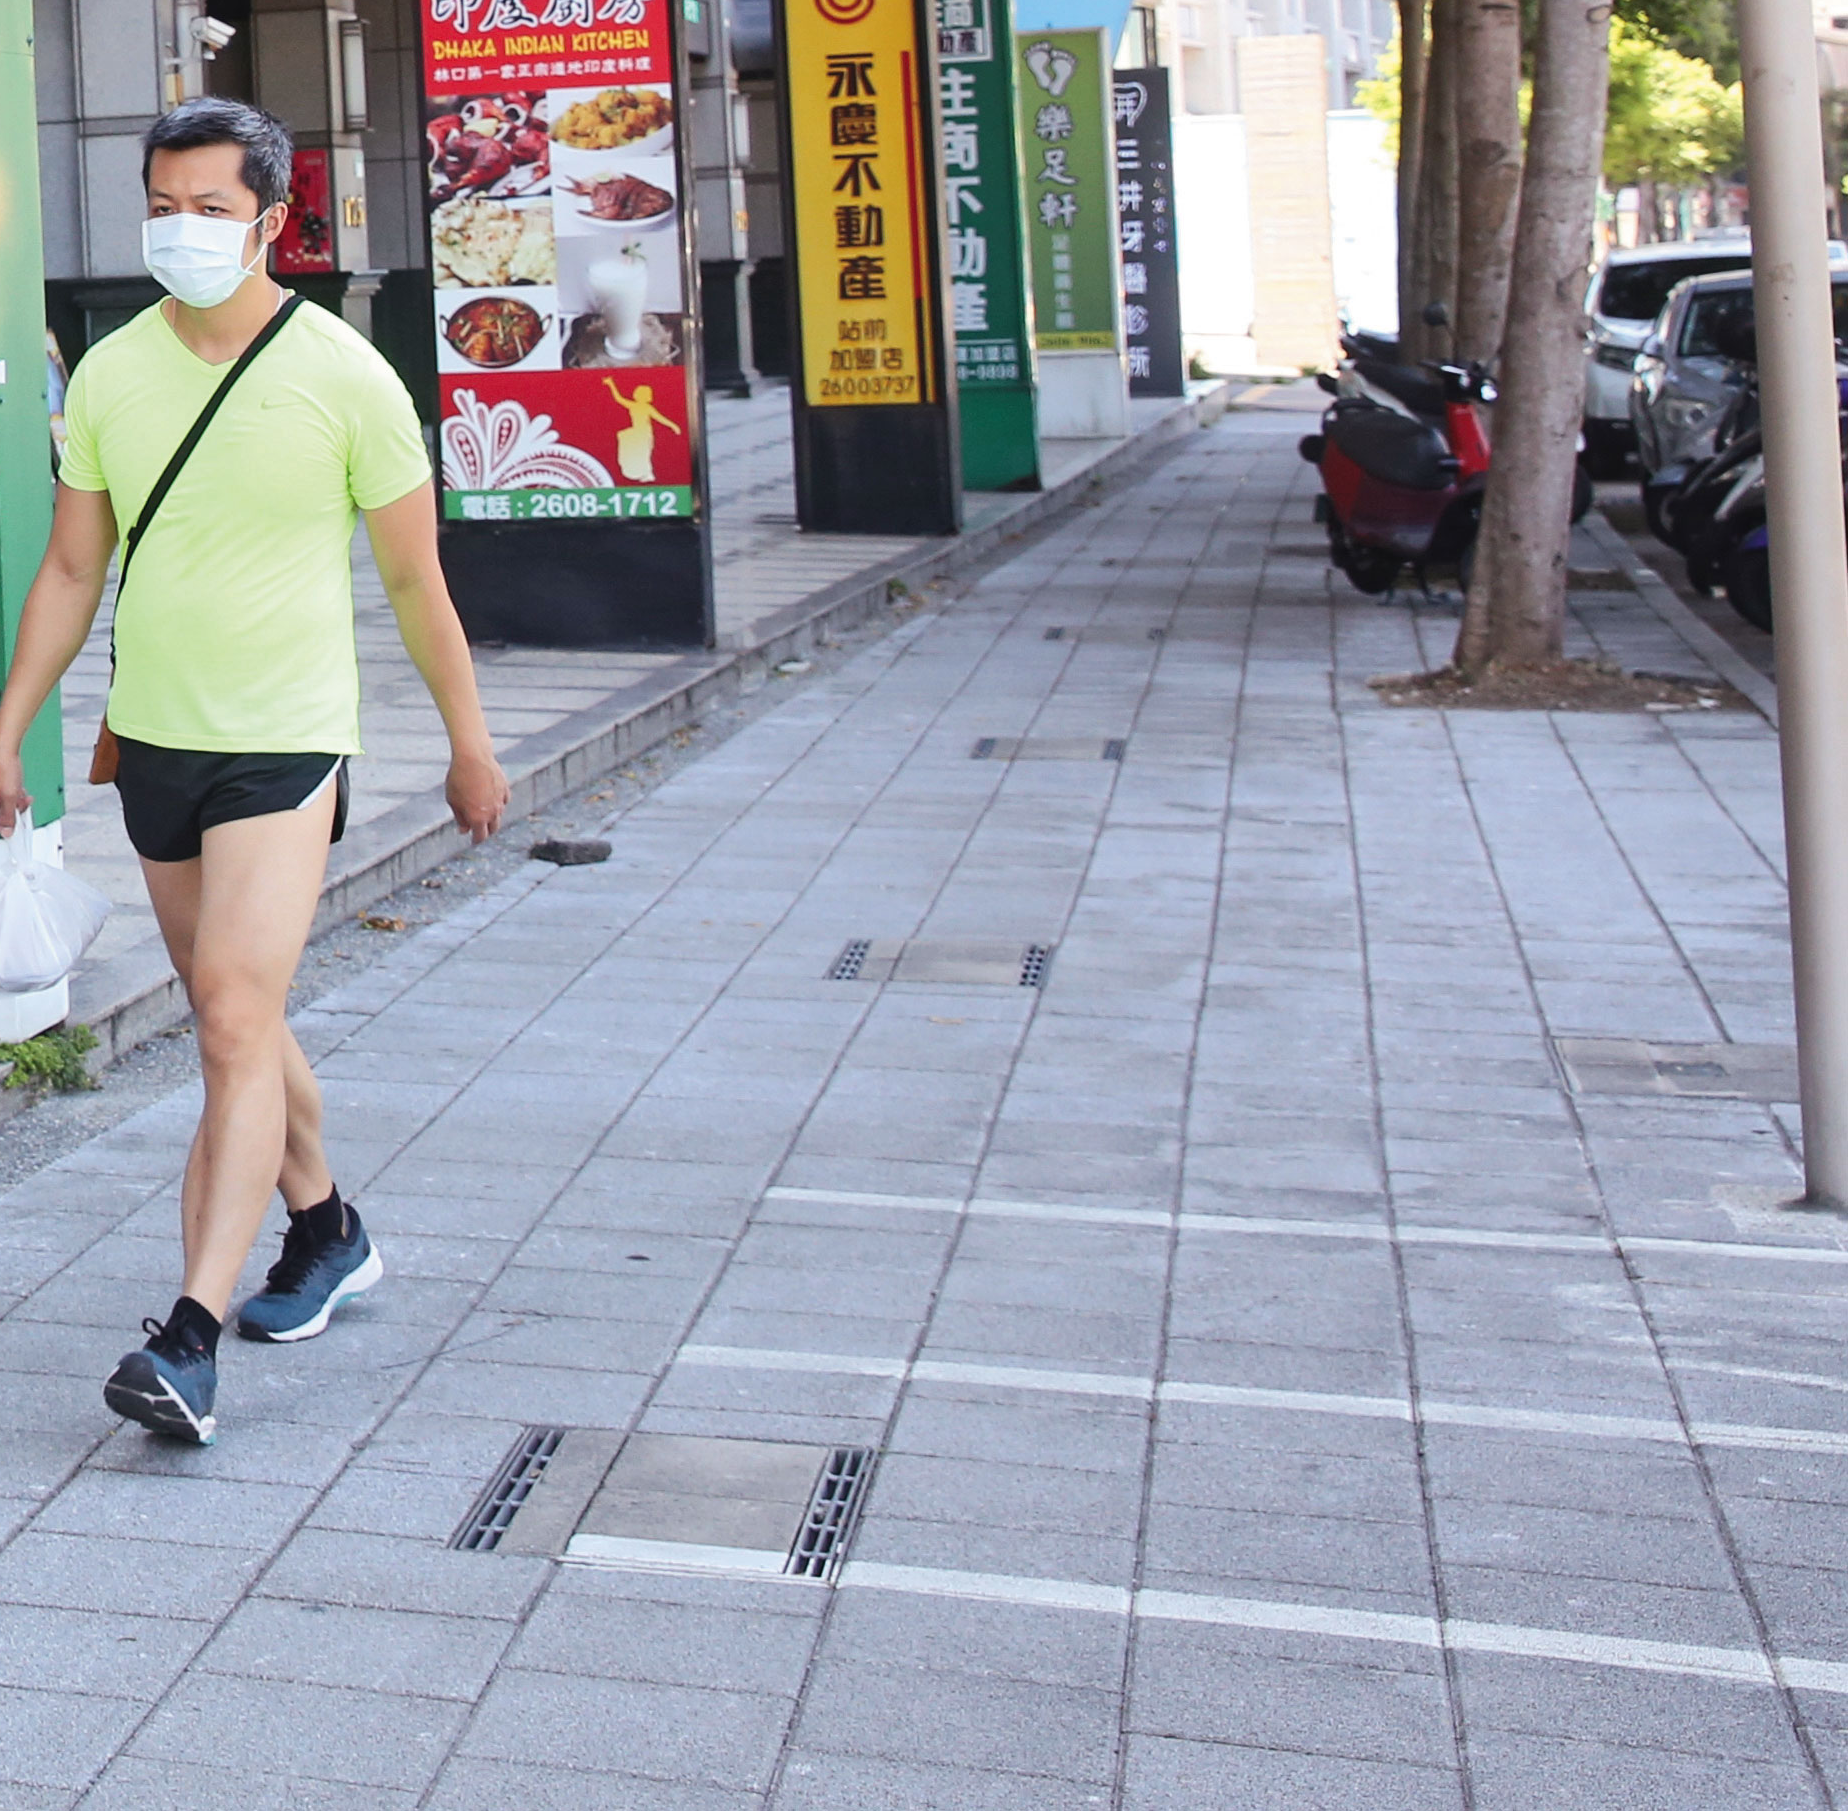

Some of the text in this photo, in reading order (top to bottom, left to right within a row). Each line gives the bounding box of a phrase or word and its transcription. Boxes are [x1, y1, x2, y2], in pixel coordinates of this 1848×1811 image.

[432, 30, 650, 60] DHAKA INDIAN KITCHEN
[826, 52, 887, 301] 永慶不動產
[1034, 101, 1080, 229] 樂足軒
[1115, 138, 1151, 379] 三井牙醫診所
[819, 374, 915, 397] 26003737
[829, 346, 903, 371] 加盟店
